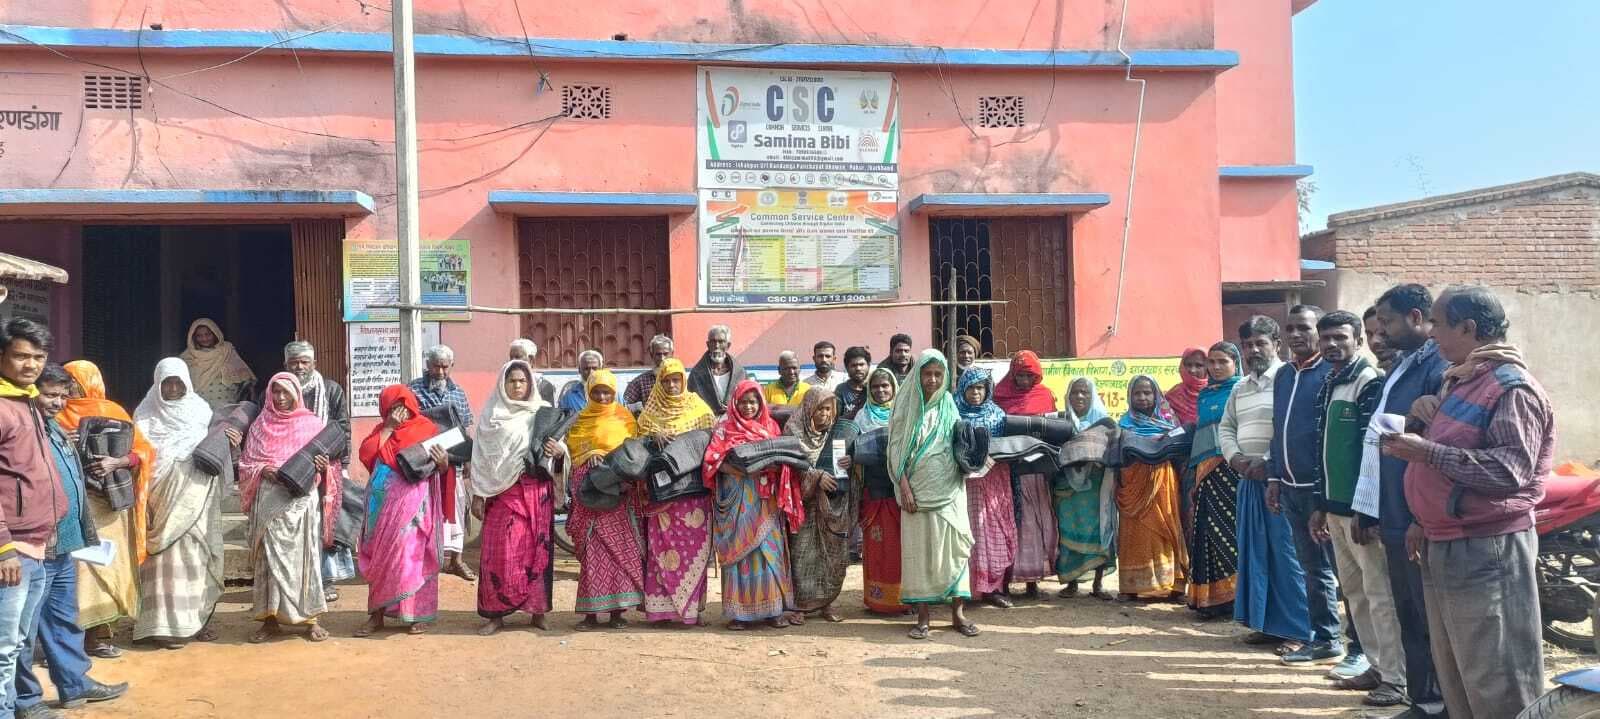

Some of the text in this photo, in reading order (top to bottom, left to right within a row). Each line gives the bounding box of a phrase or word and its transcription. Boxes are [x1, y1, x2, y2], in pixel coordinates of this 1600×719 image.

[766, 85, 834, 122] CSC
[754, 134, 850, 149] Samima Bibi
[751, 213, 854, 221] Common Service Centre
